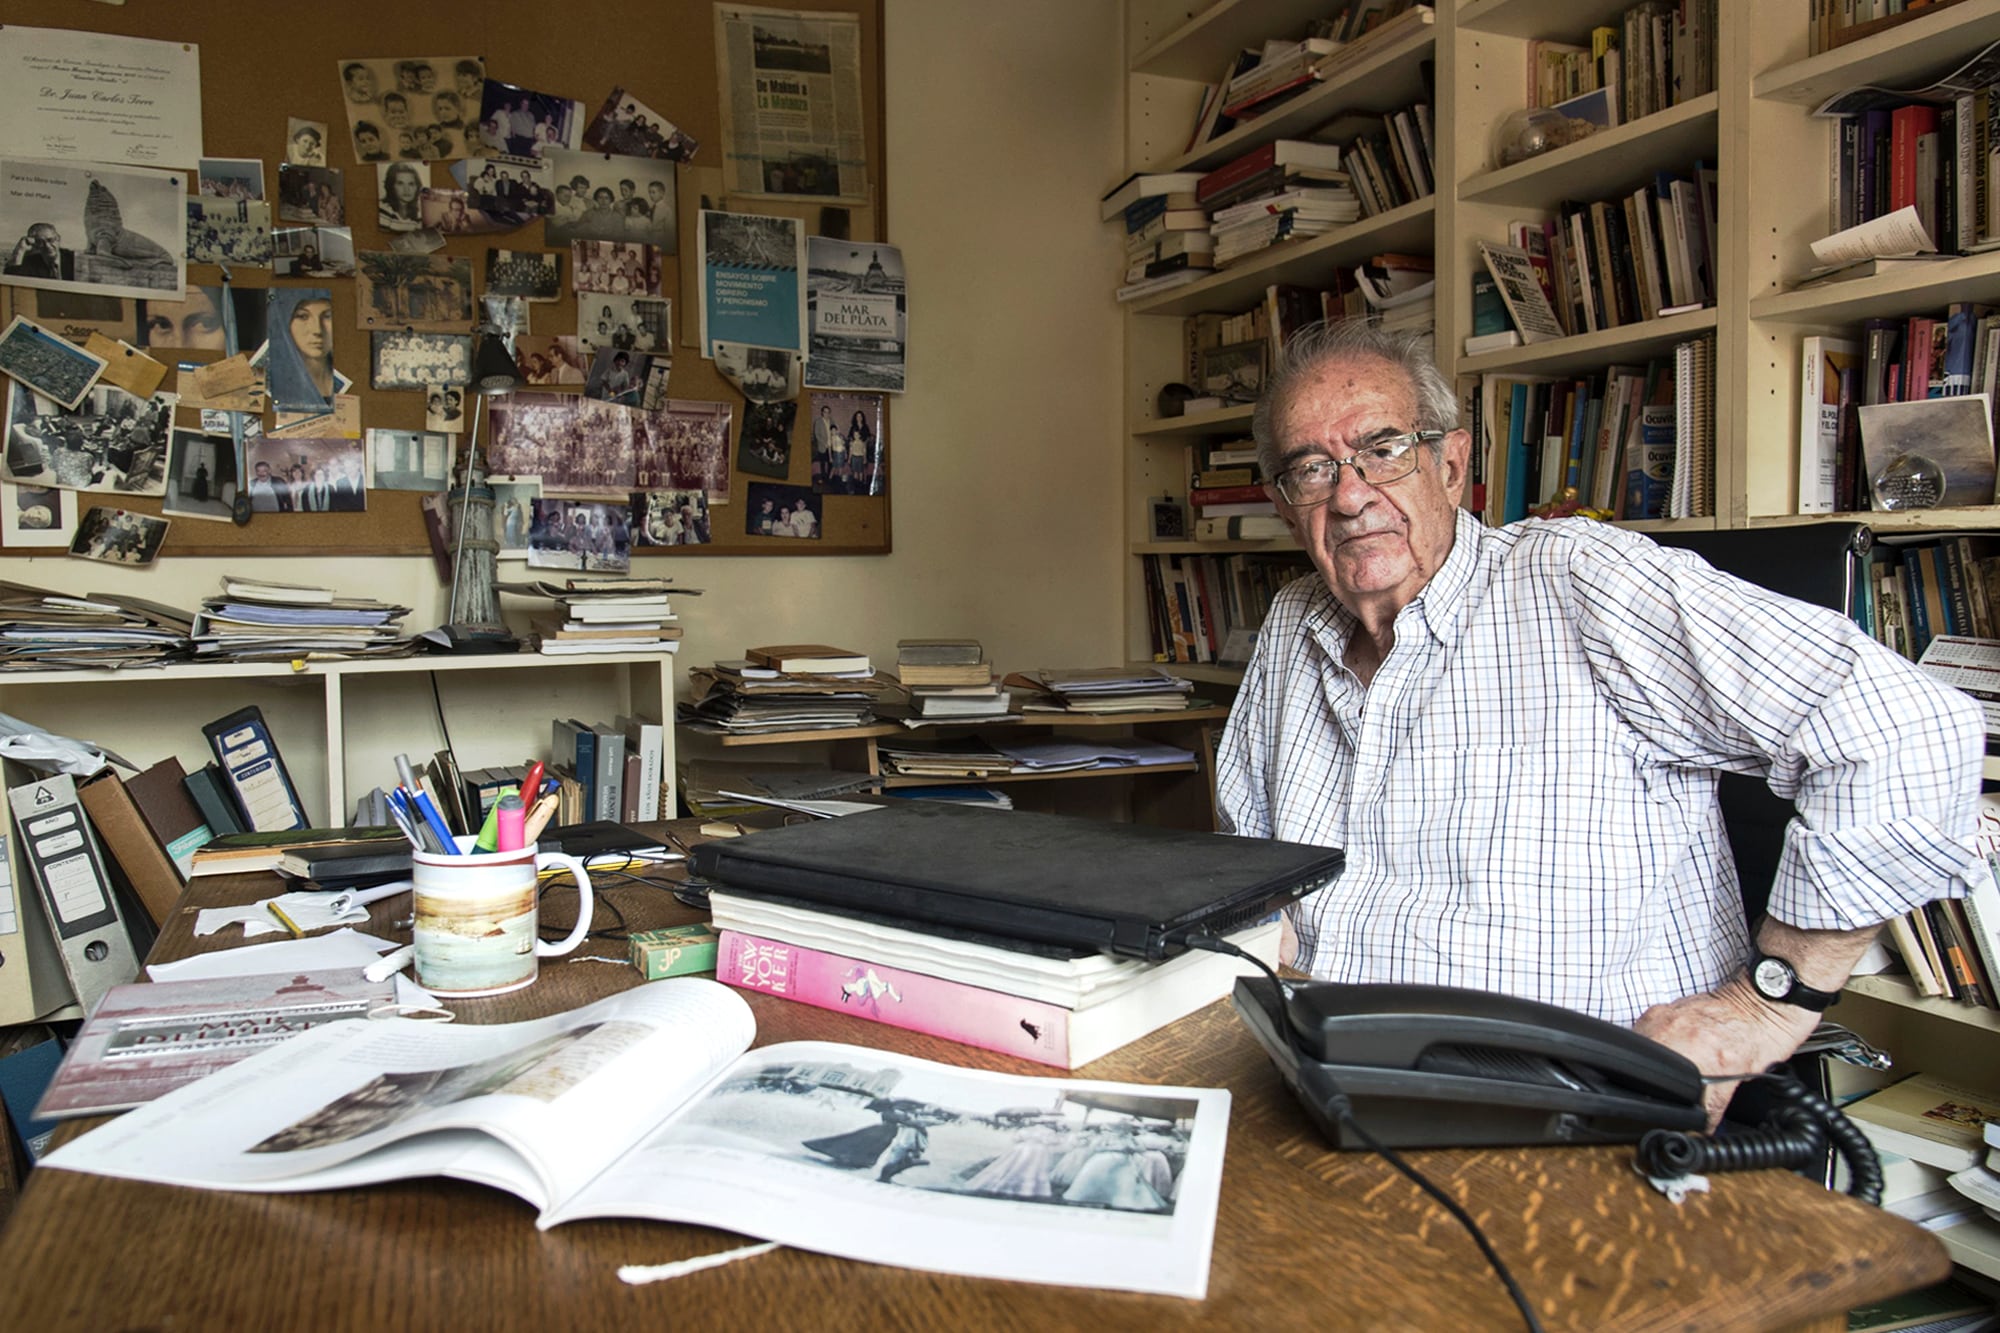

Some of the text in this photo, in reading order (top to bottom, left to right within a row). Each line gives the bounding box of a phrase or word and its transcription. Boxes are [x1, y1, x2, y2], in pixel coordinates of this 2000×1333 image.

[59, 89, 87, 101] Juan
[92, 91, 124, 104] Carlos
[128, 94, 154, 106] Torre
[715, 271, 777, 283] ENSAYOS SOBRE
[715, 280, 764, 290] MOVIMIENTO
[715, 289, 749, 298] OBRERO
[723, 298, 769, 308] PERONISMO
[841, 304, 869, 316] MAR
[824, 312, 888, 327] DEL PLATA
[742, 939, 758, 986] NEW
[757, 945, 774, 987] YOR
[771, 947, 789, 993] KER
[198, 1016, 286, 1031] MAR
[226, 1020, 331, 1038] PLAT
